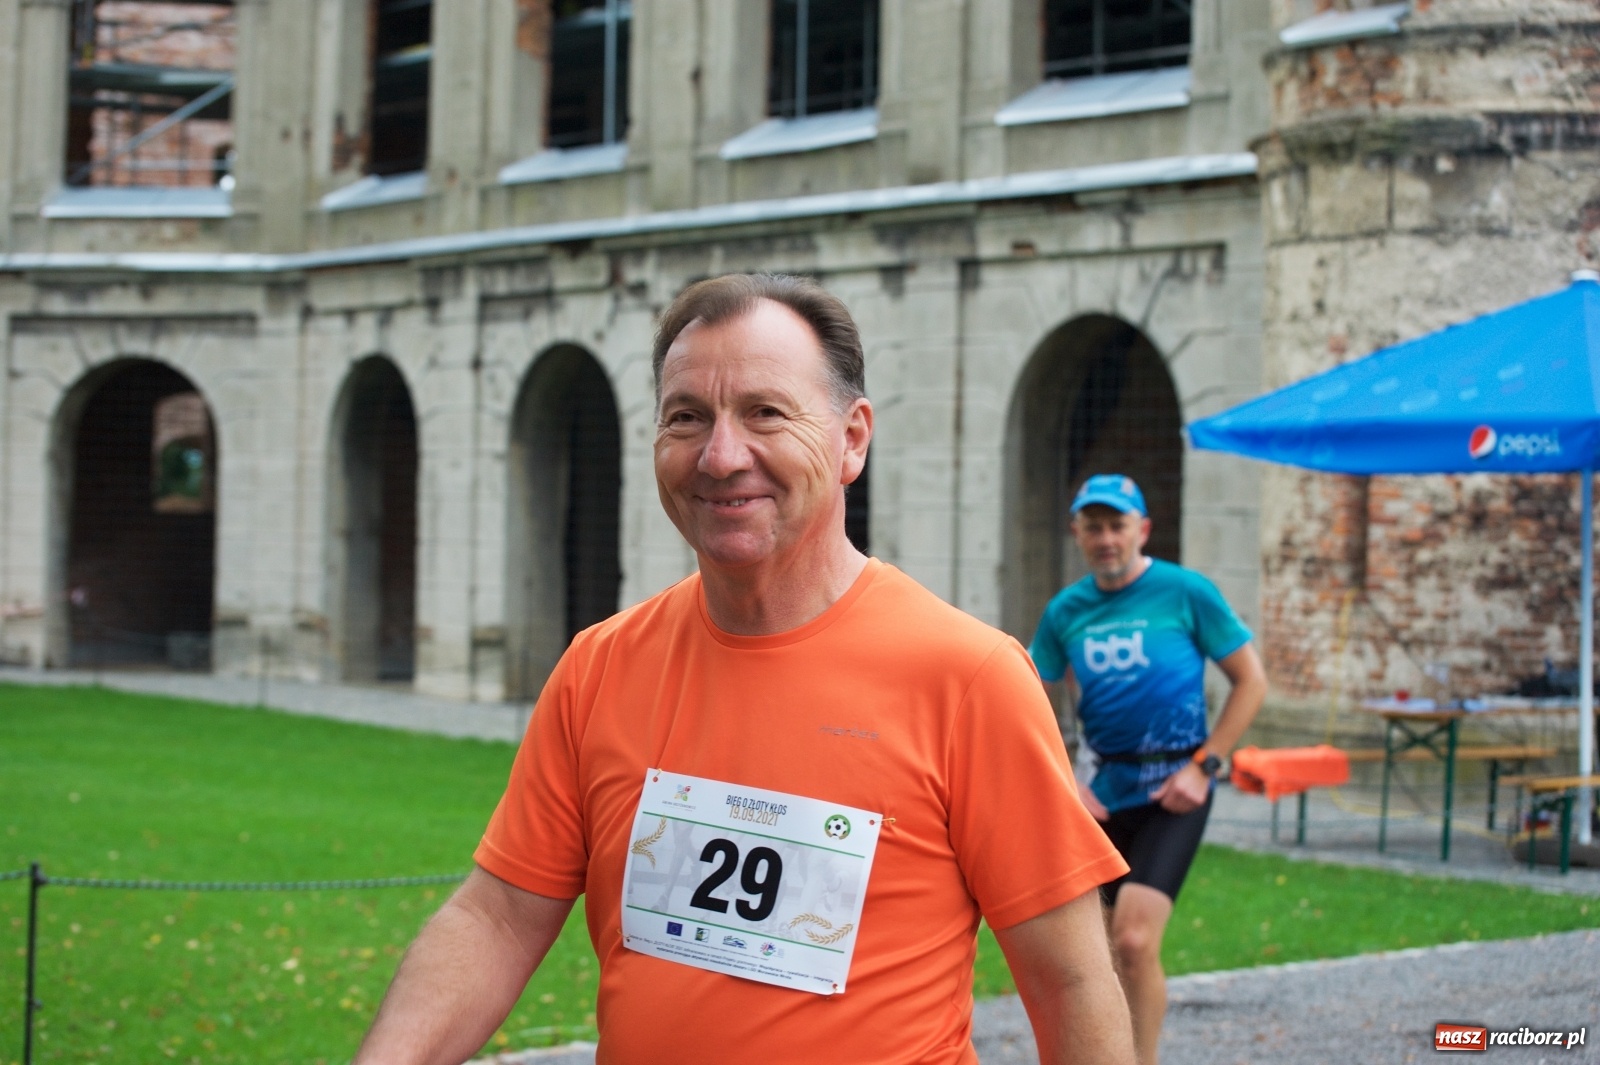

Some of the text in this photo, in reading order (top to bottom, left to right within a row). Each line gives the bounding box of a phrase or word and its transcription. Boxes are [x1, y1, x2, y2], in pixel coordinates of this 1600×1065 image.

[1497, 428, 1561, 460] pepsi
[726, 795, 787, 815] BIEG O ZŁOTY KŁOS
[729, 806, 778, 826] 19.09.2021
[689, 838, 783, 922] 29
